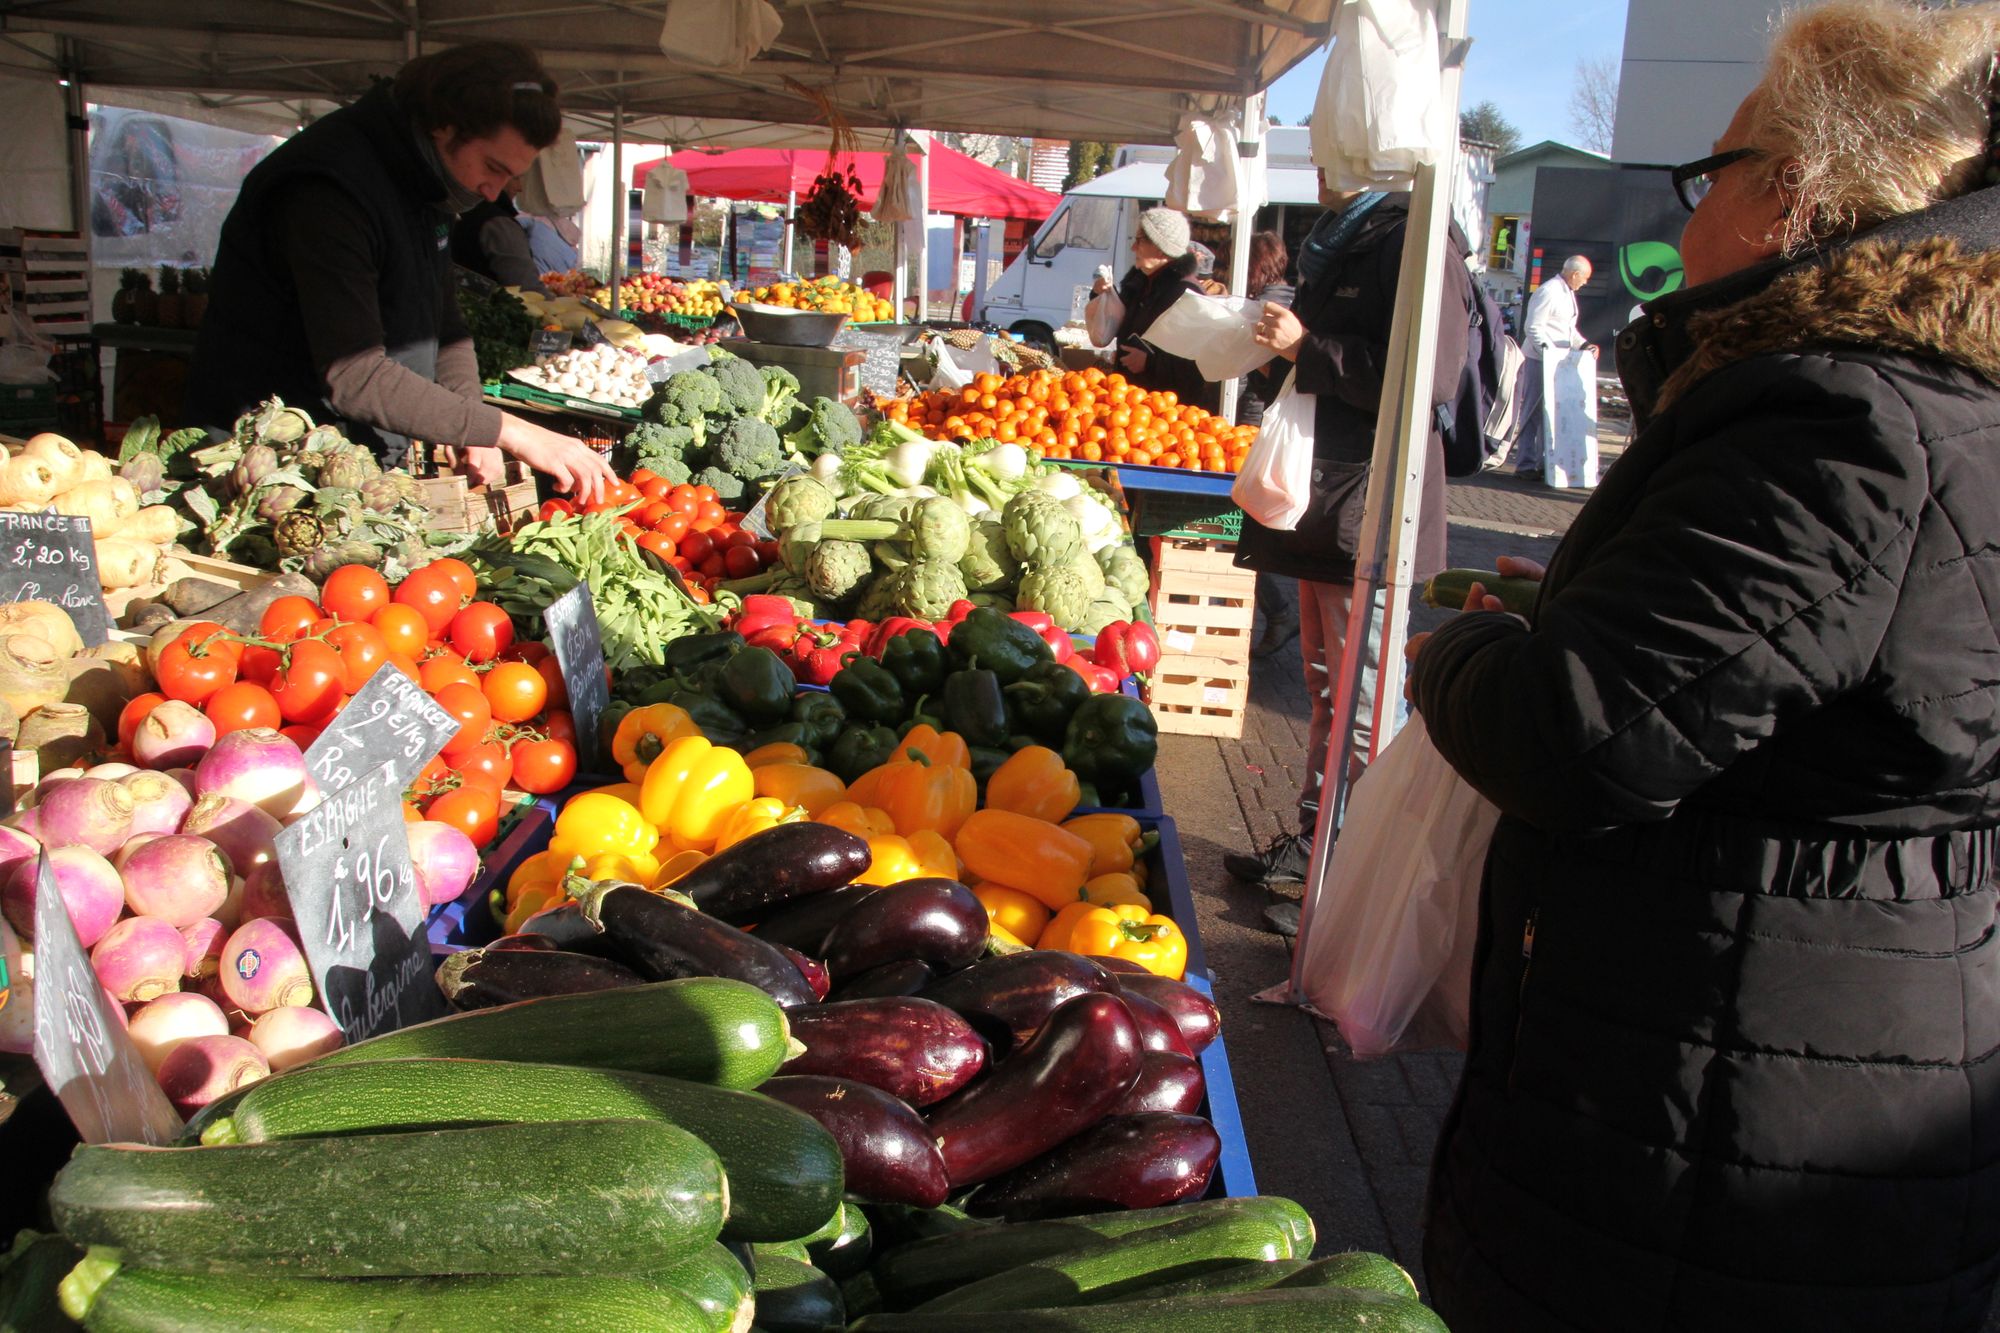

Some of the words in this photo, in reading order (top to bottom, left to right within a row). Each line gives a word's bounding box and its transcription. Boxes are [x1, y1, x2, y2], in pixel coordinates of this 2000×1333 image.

[0, 512, 70, 532] FRANCE
[381, 672, 447, 727] FRANCE
[301, 776, 378, 858] ESPAGNE
